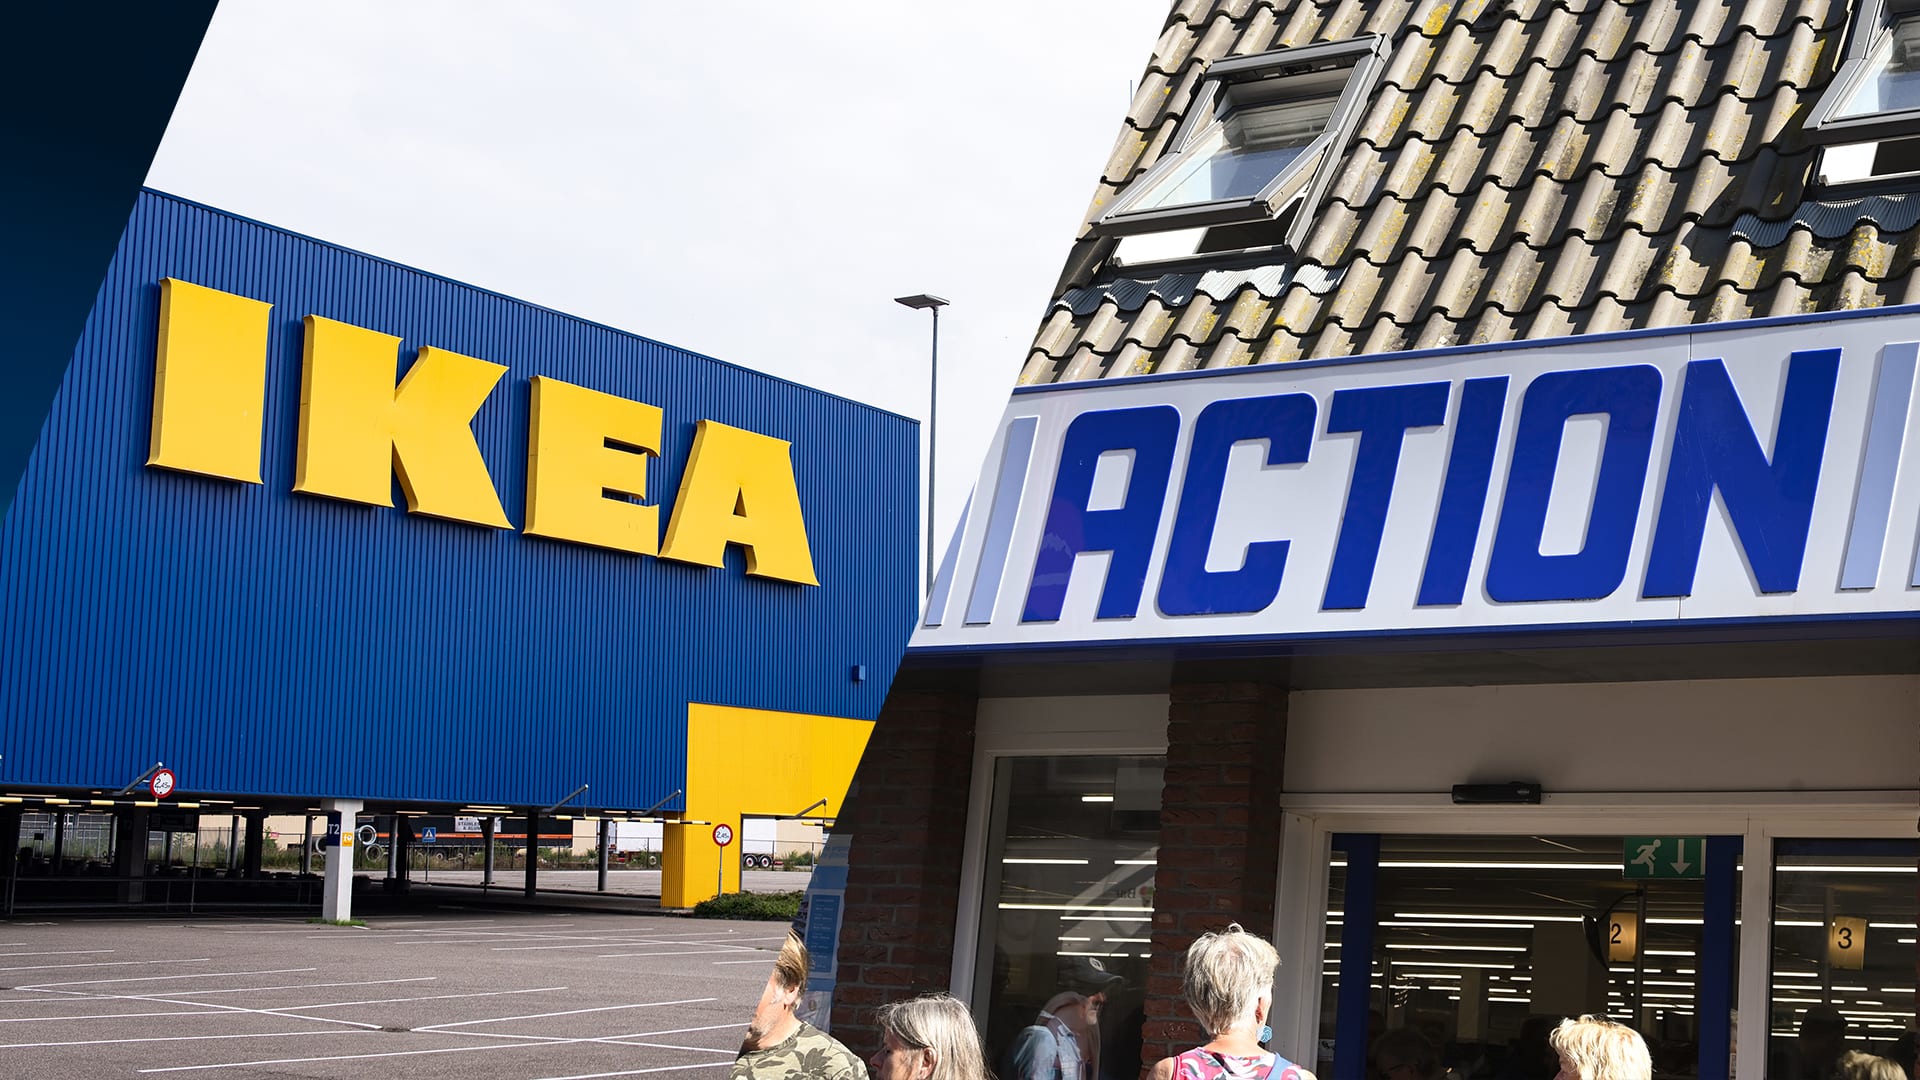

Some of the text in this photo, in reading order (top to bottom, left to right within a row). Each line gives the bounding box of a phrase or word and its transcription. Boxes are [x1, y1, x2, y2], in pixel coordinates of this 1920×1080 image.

[146, 277, 820, 586] IKEA
[1020, 347, 1844, 623] ACTION
[328, 823, 340, 835] T2
[1610, 922, 1622, 945] 2
[1837, 927, 1852, 950] 3
